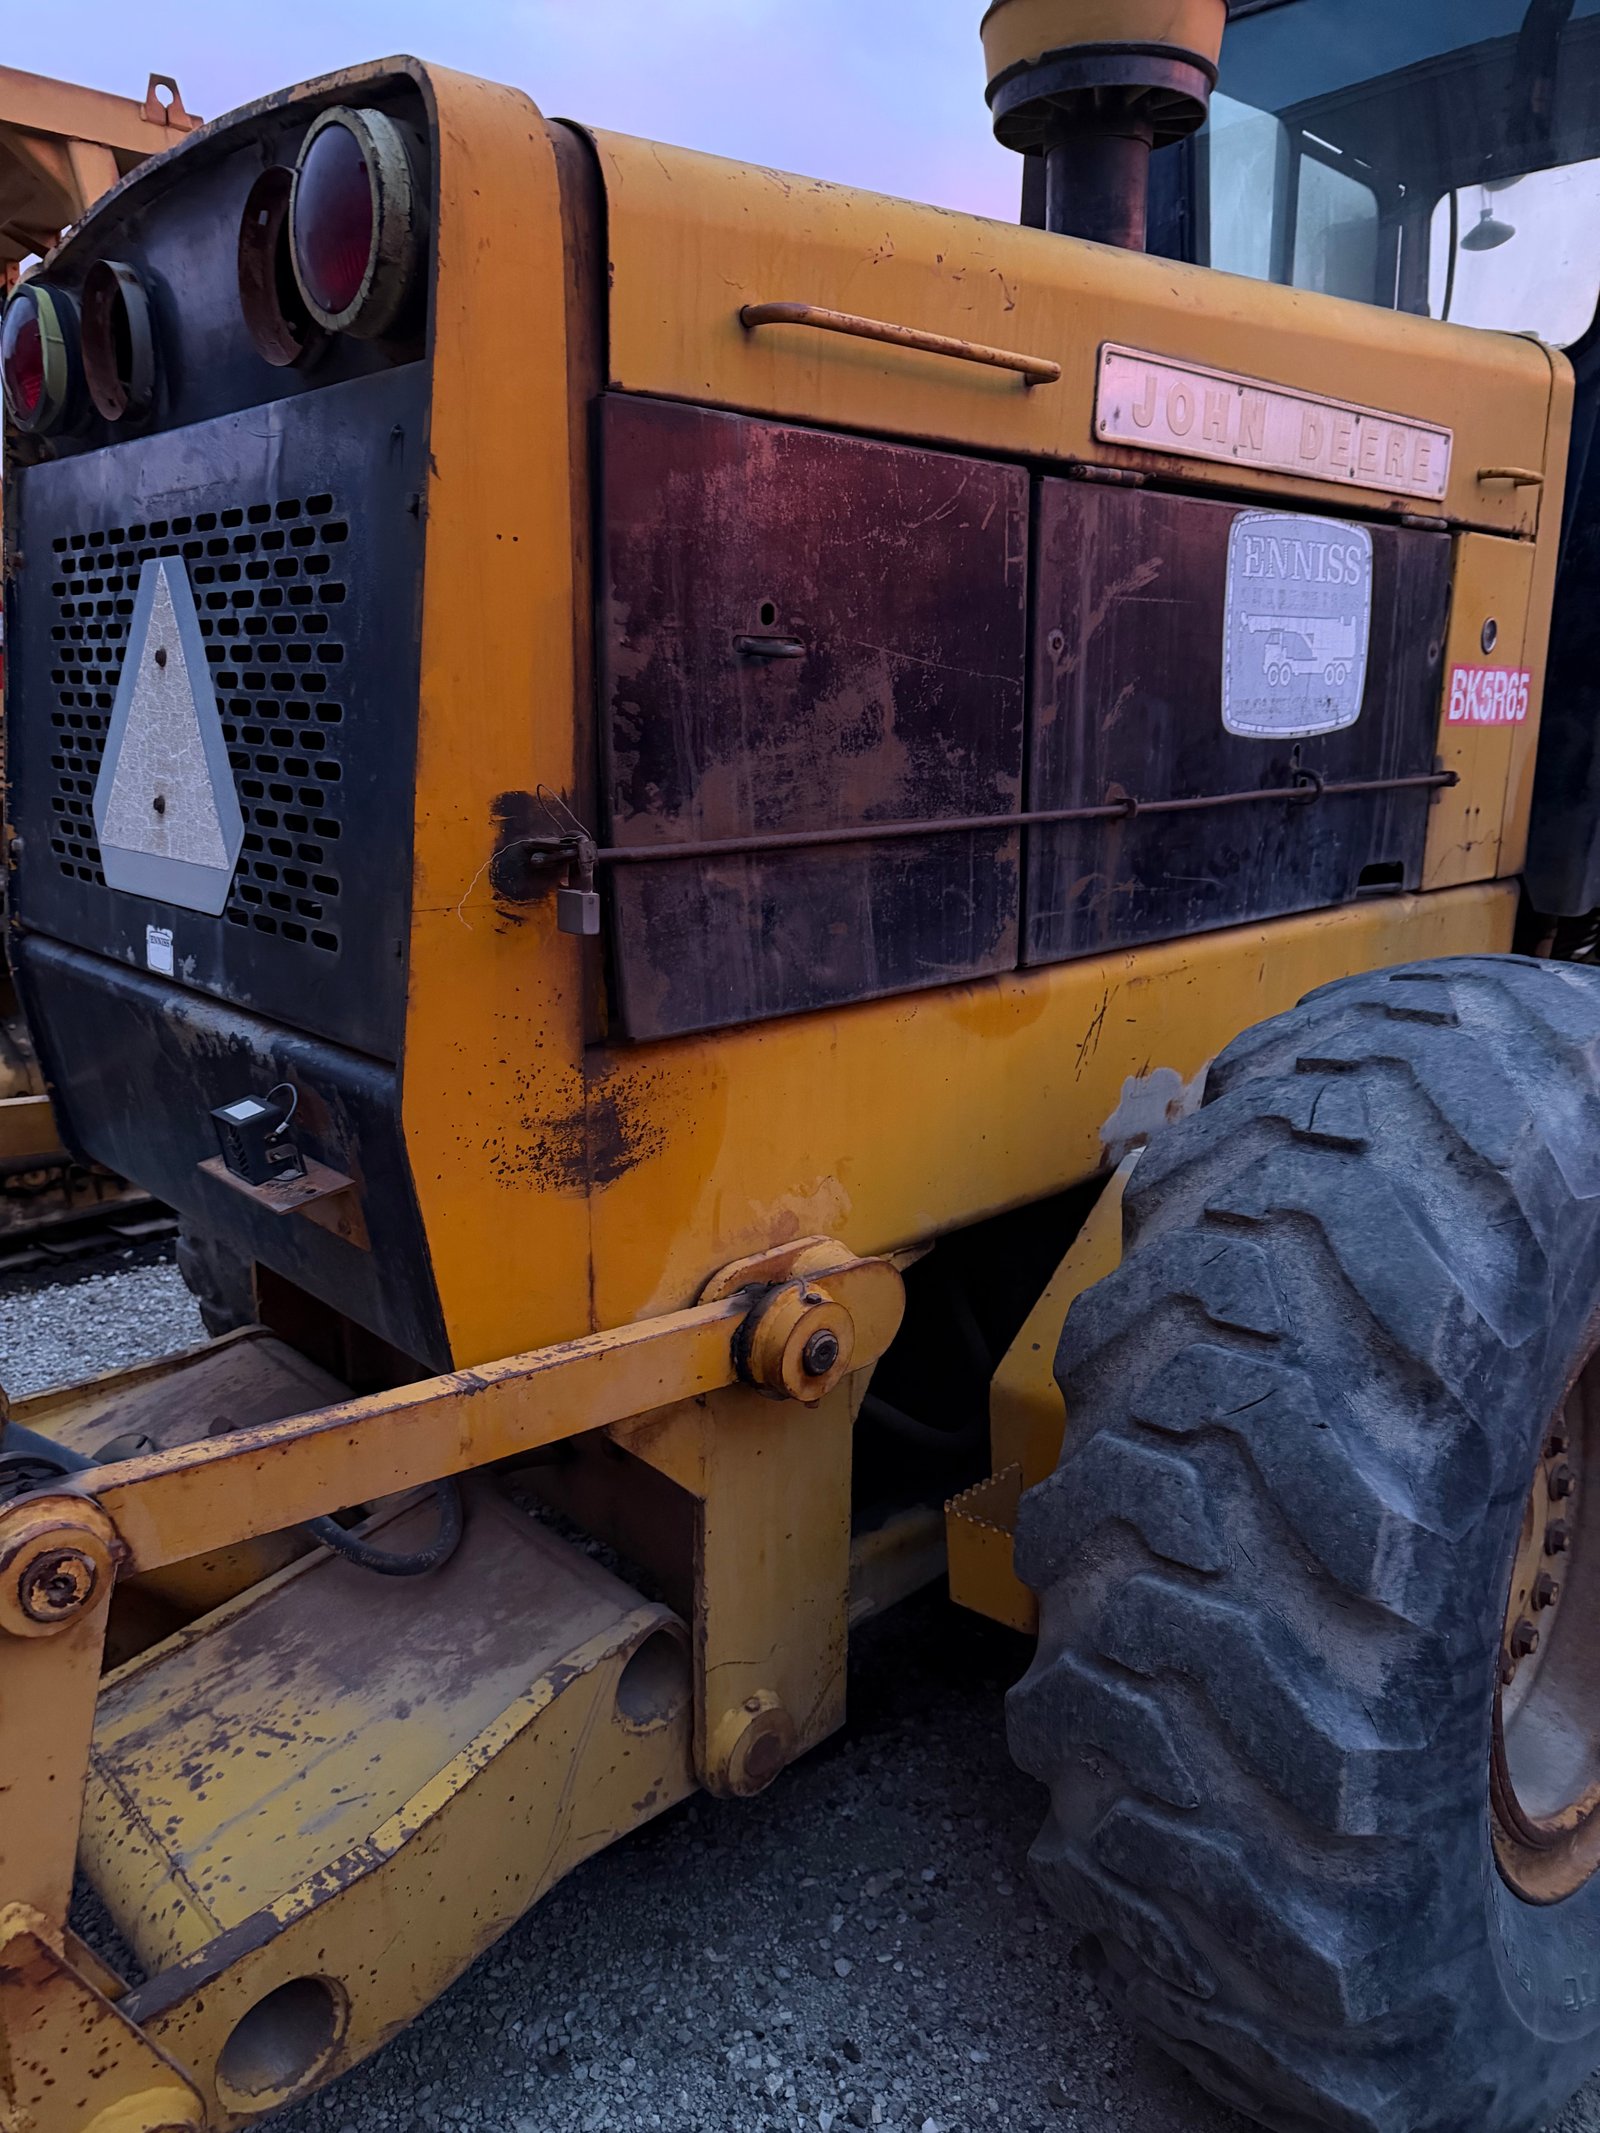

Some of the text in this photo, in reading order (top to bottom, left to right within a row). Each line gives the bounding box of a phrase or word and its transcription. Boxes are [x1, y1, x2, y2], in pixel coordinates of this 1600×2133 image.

[1131, 374, 1431, 483] JOHN DEERE
[1241, 534, 1362, 586] ENNISS
